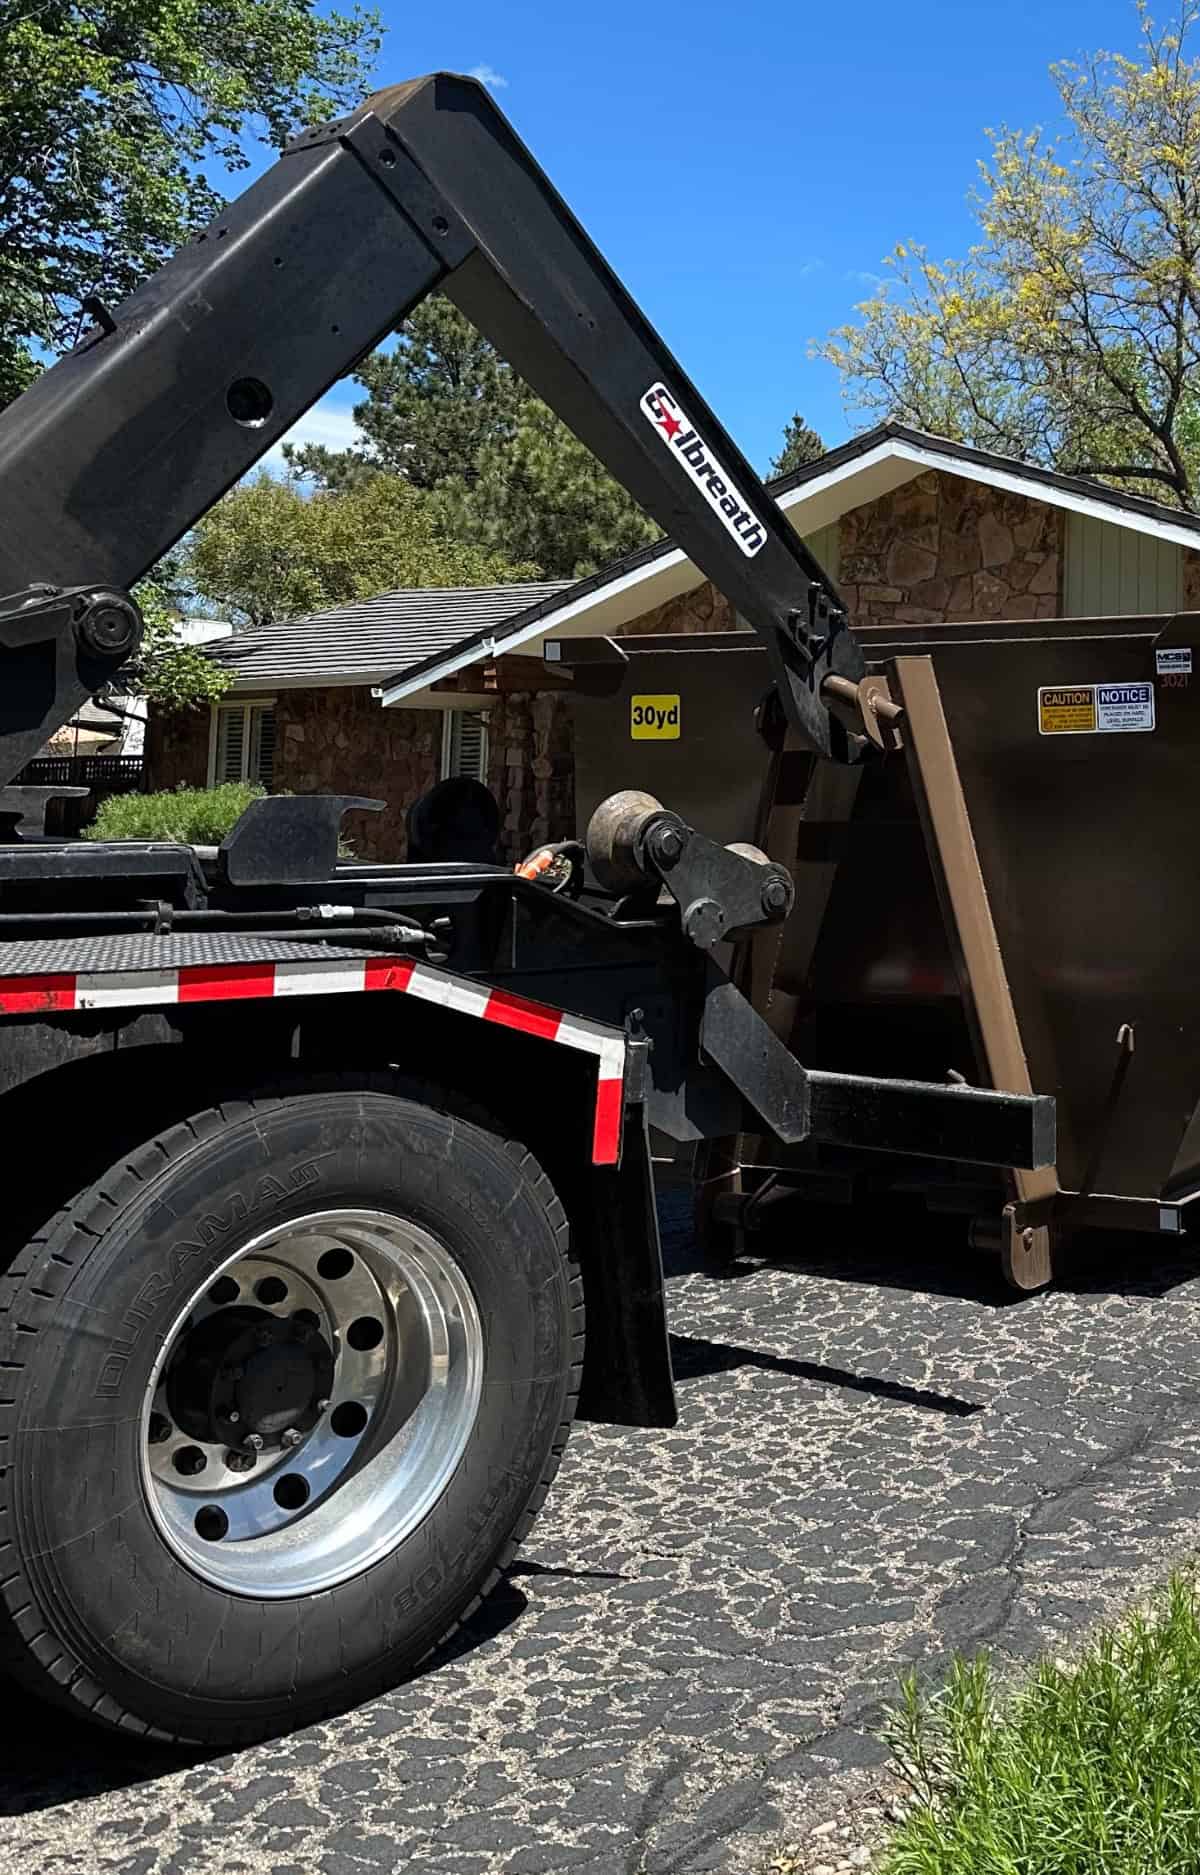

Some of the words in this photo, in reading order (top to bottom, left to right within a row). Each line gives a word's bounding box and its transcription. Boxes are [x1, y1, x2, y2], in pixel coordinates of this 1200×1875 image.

[1044, 692, 1090, 705] CAUTION
[1101, 689, 1148, 703] NOTICE
[633, 705, 678, 730] 30yd
